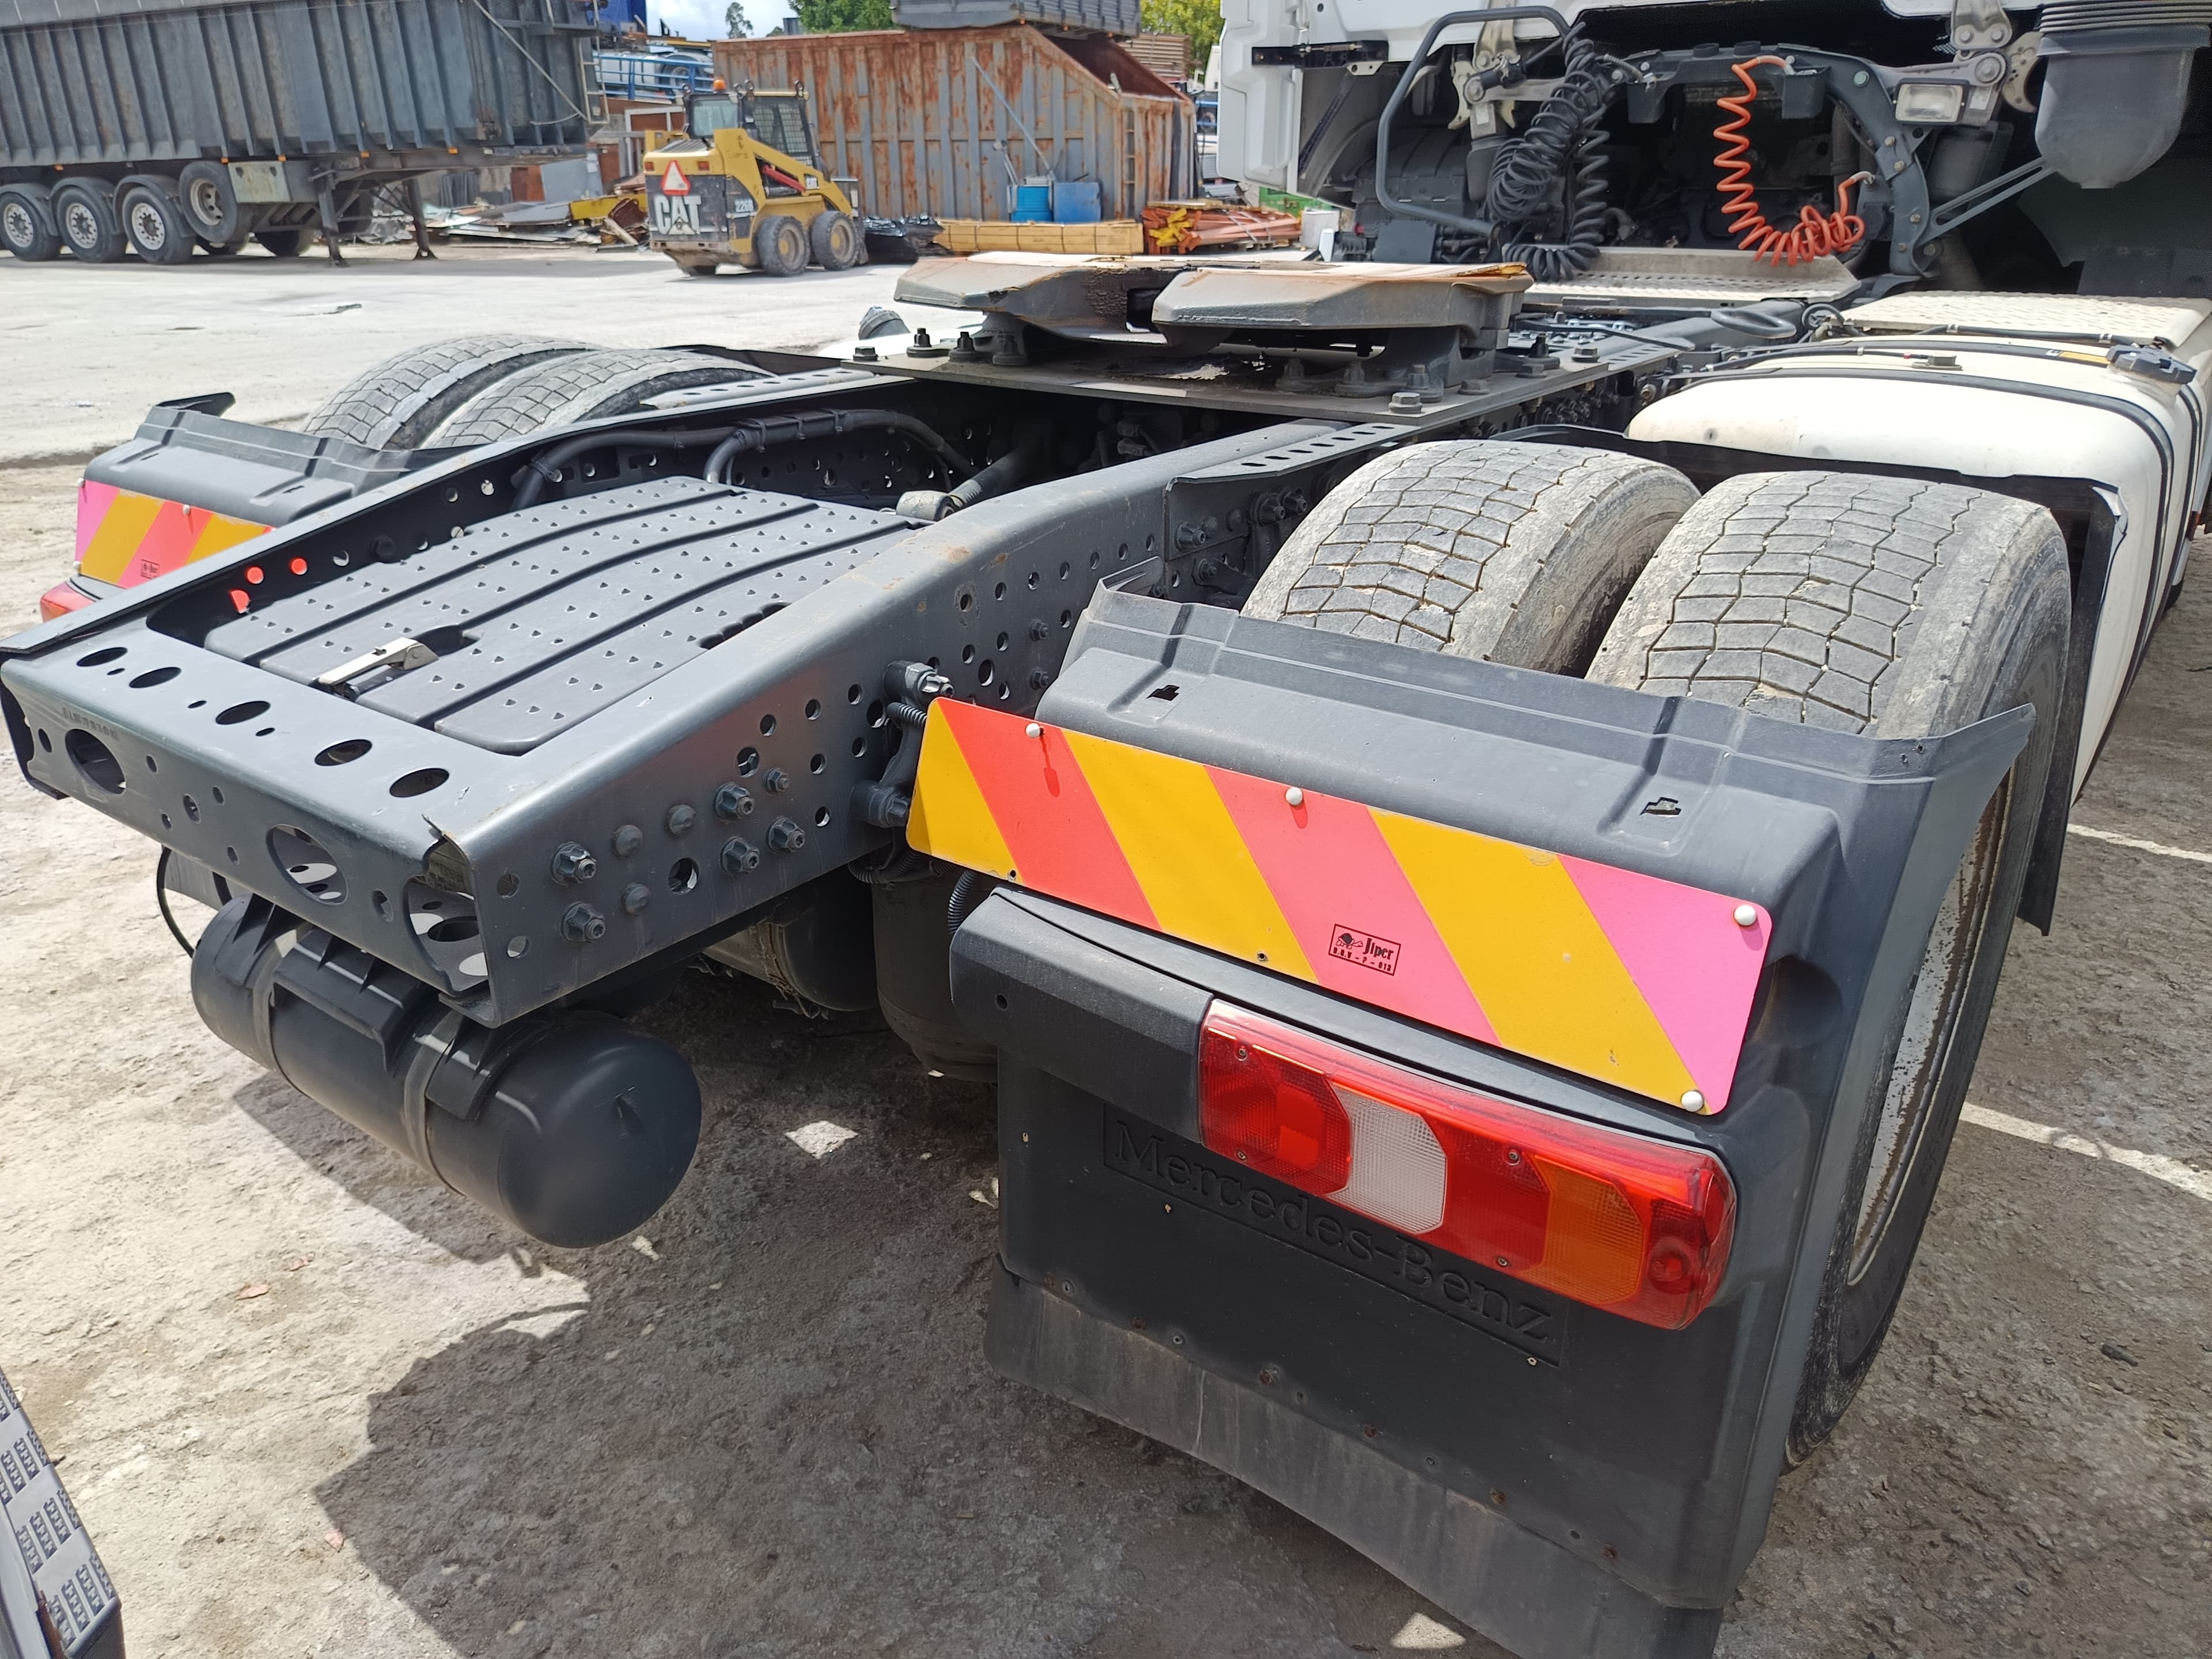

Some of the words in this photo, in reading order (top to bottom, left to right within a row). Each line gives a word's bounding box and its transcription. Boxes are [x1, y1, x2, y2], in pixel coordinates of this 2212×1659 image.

[654, 195, 702, 235] CAT
[1362, 937, 1394, 960] Jiper
[1116, 1119, 1554, 1344] Mercedes-Benz
